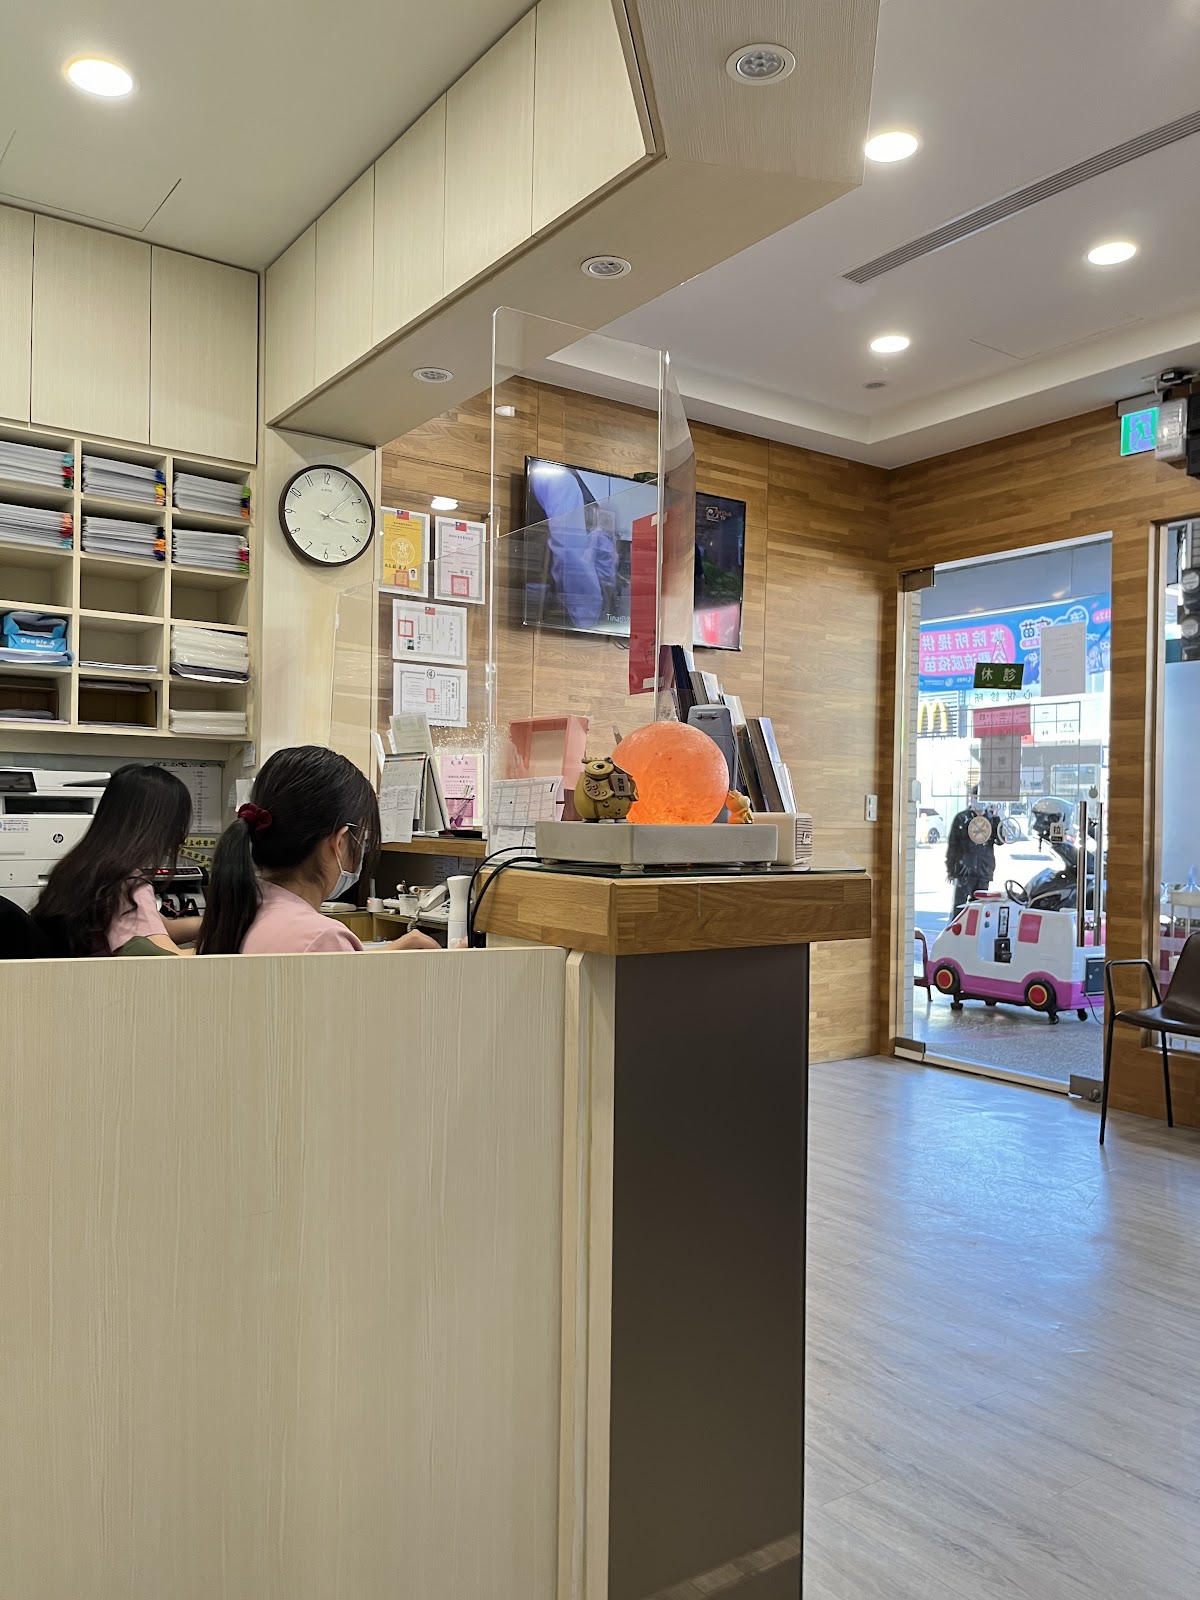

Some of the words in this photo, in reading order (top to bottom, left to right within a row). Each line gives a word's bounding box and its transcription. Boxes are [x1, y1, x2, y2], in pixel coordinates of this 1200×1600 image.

[304, 474, 314, 487] 11
[323, 472, 331, 485] 12
[341, 481, 348, 491] 1
[289, 487, 302, 499] 10
[351, 498, 362, 506] 2
[290, 527, 301, 535] 8
[351, 535, 362, 543] 4
[304, 541, 313, 551] 7
[339, 545, 348, 557] 5
[323, 548, 329, 560] 6
[980, 666, 1017, 683] 休診
[1053, 825, 1061, 835] 拉
[53, 833, 64, 844] hp
